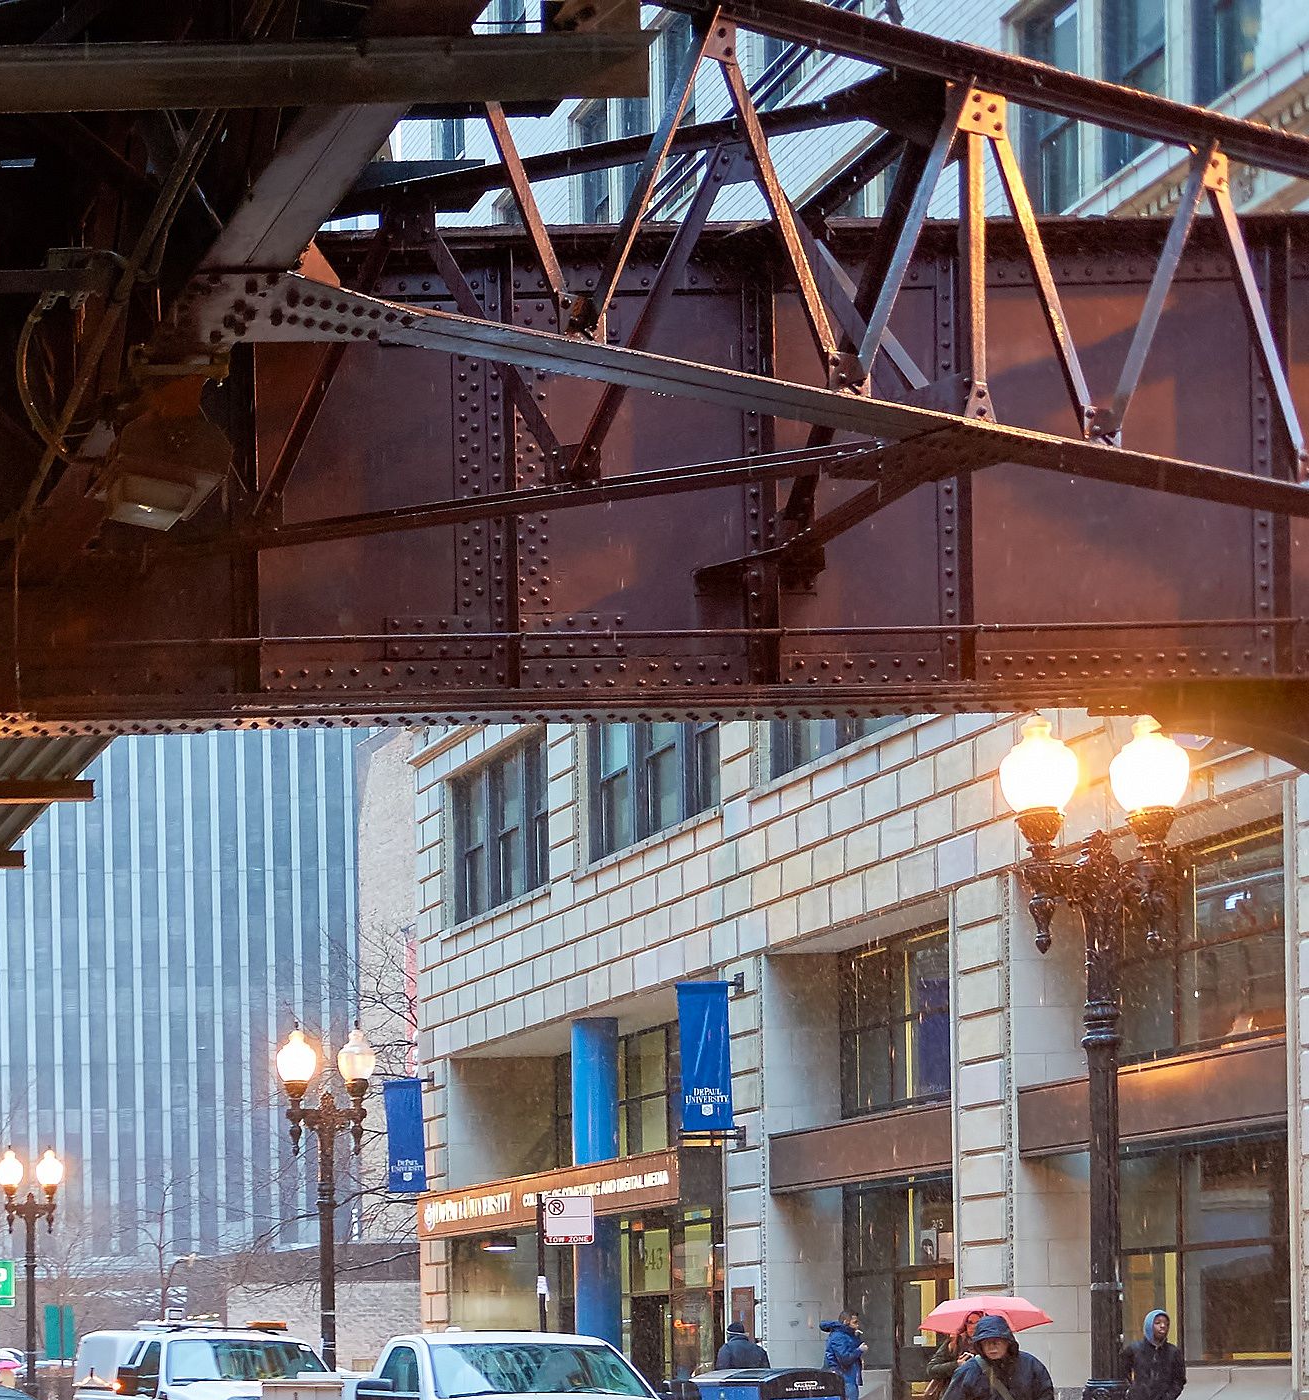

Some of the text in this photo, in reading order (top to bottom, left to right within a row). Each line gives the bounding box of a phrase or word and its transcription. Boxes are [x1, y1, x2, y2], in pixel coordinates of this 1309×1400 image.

[685, 1095, 729, 1105] UNIVERSITY
[522, 1189, 551, 1207] COLLGE
[601, 1180, 617, 1195] AND
[617, 1175, 644, 1193] DIGITAL
[644, 1170, 669, 1188] MEDIA
[463, 1192, 512, 1219] UNIVERSITY
